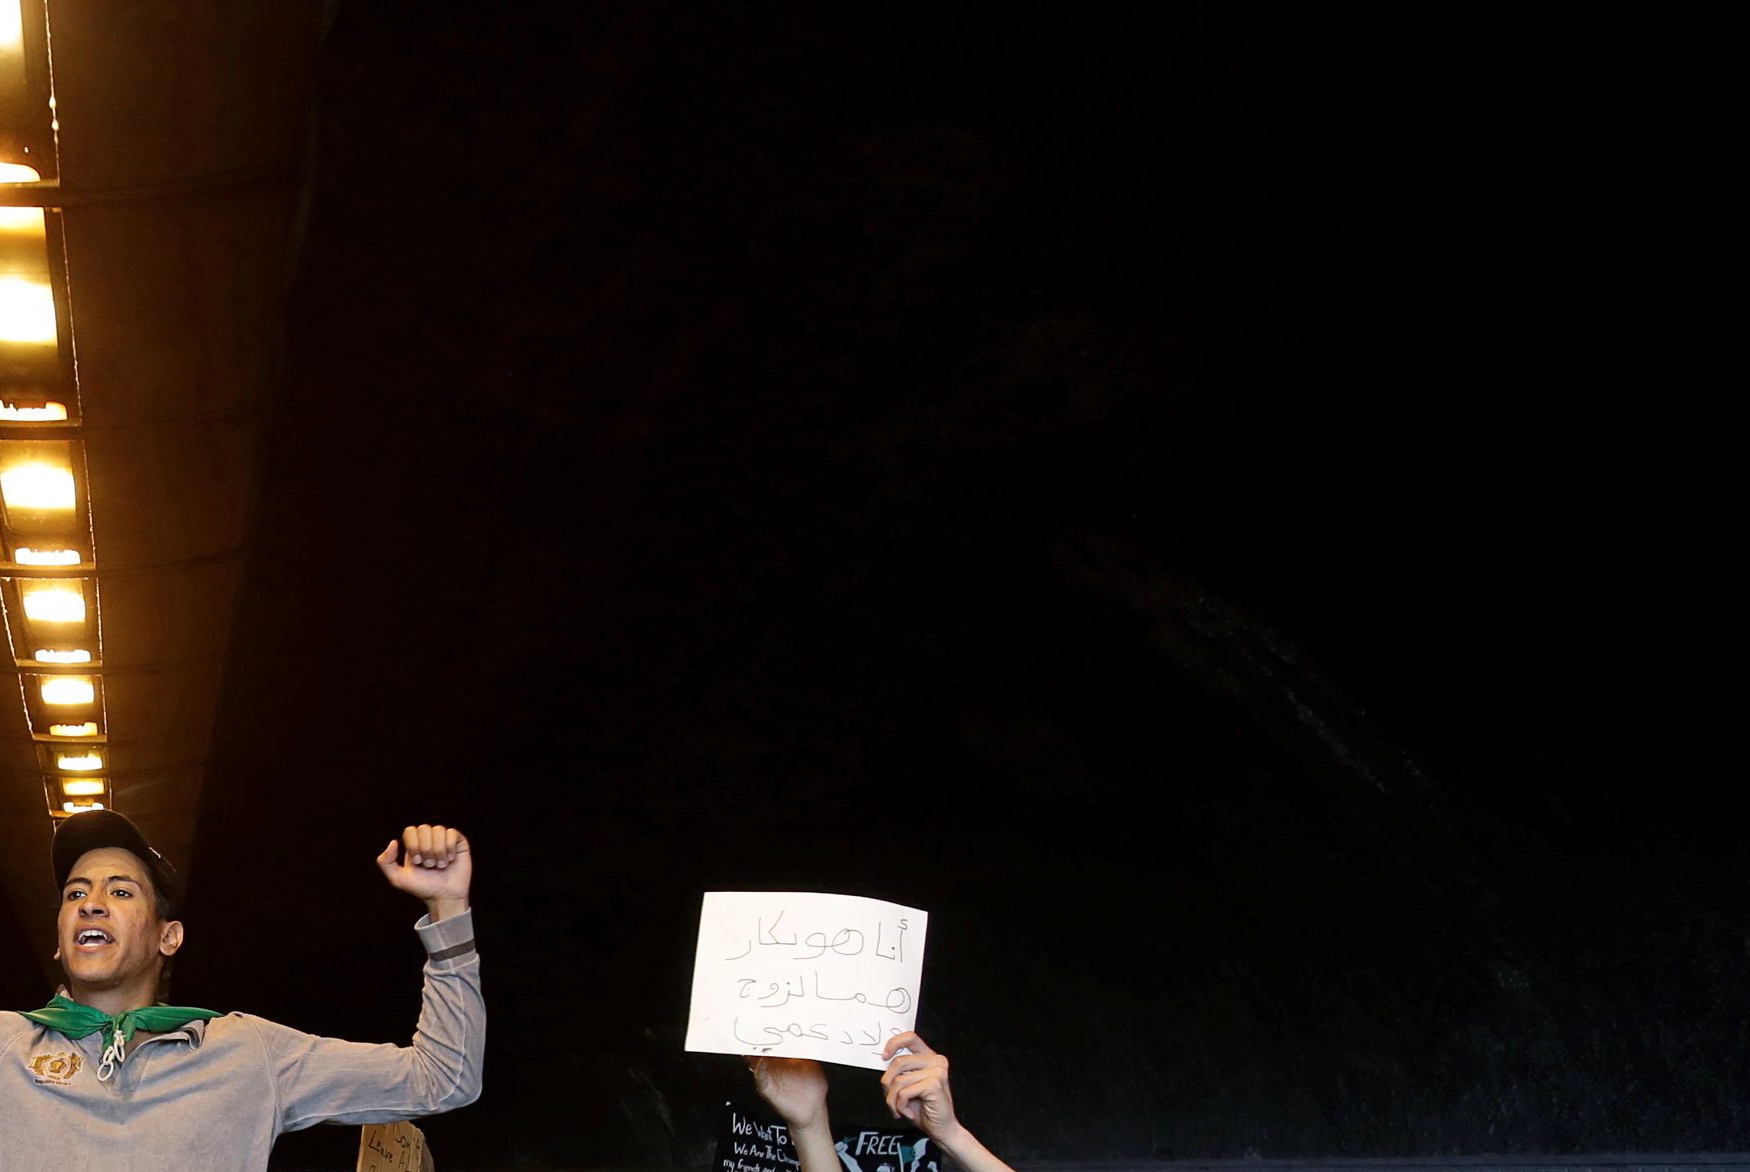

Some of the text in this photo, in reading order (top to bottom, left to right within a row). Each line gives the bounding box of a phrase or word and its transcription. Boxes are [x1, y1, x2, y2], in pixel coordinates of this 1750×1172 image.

[733, 1112, 753, 1135] We
[770, 1125, 787, 1145] To
[734, 1141, 748, 1155] We
[749, 1144, 764, 1158] Are
[855, 1131, 904, 1156] FREE
